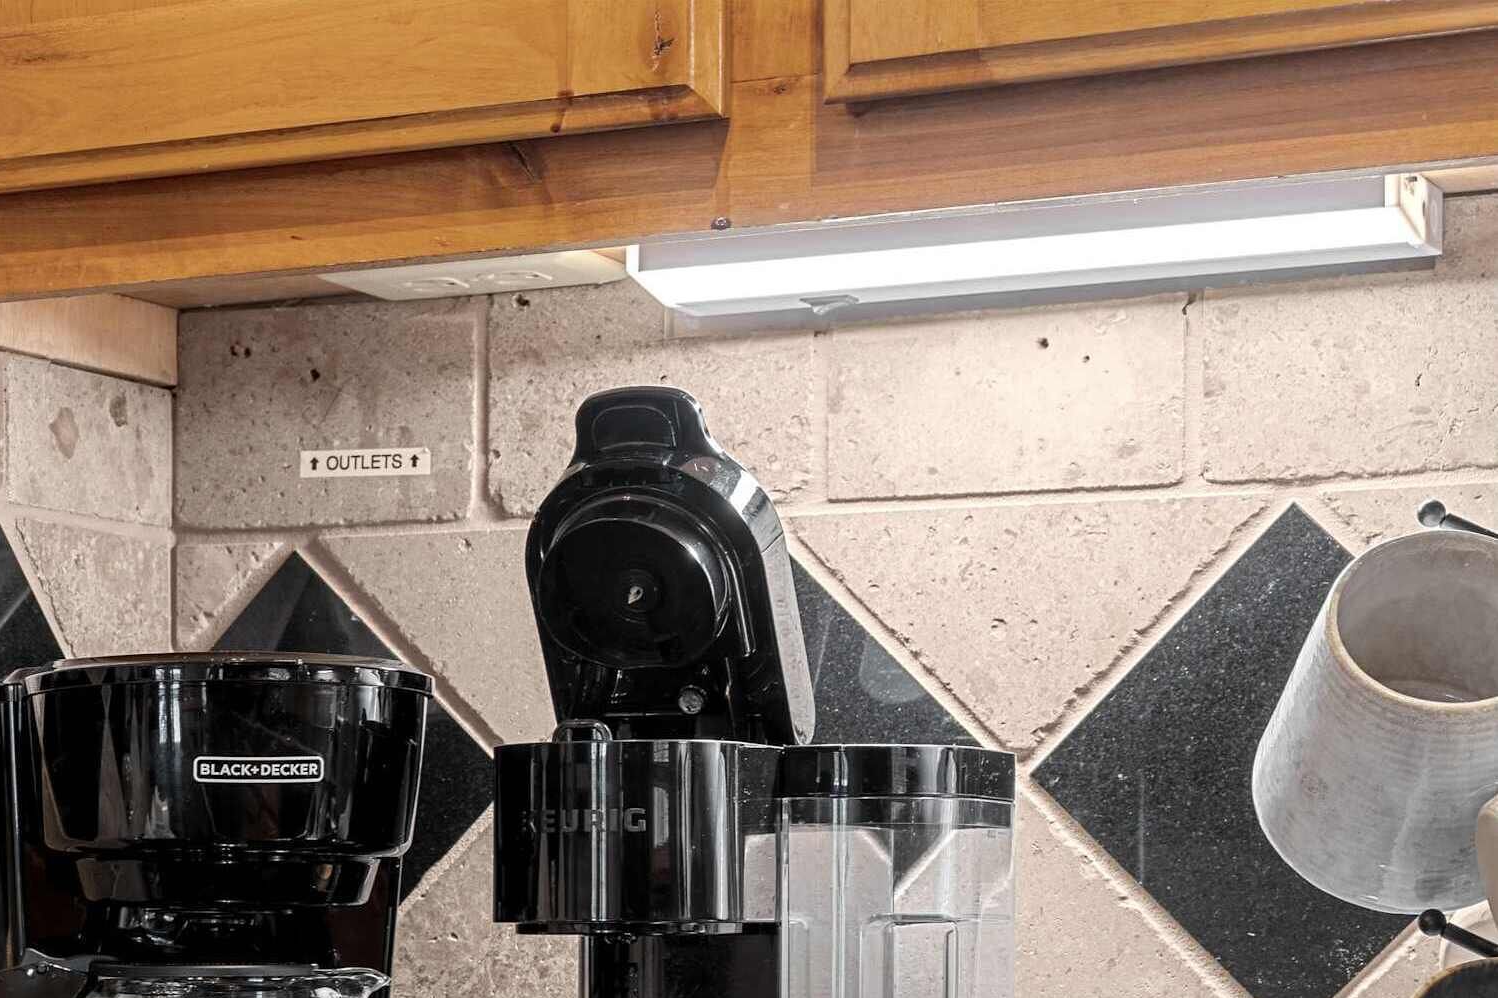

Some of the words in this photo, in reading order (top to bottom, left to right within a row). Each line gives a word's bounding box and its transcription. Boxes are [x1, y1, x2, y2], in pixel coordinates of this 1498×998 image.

[326, 454, 403, 470] OUTLETS
[200, 763, 318, 776] BLACK+DECKER
[521, 807, 647, 833] KEURIG
